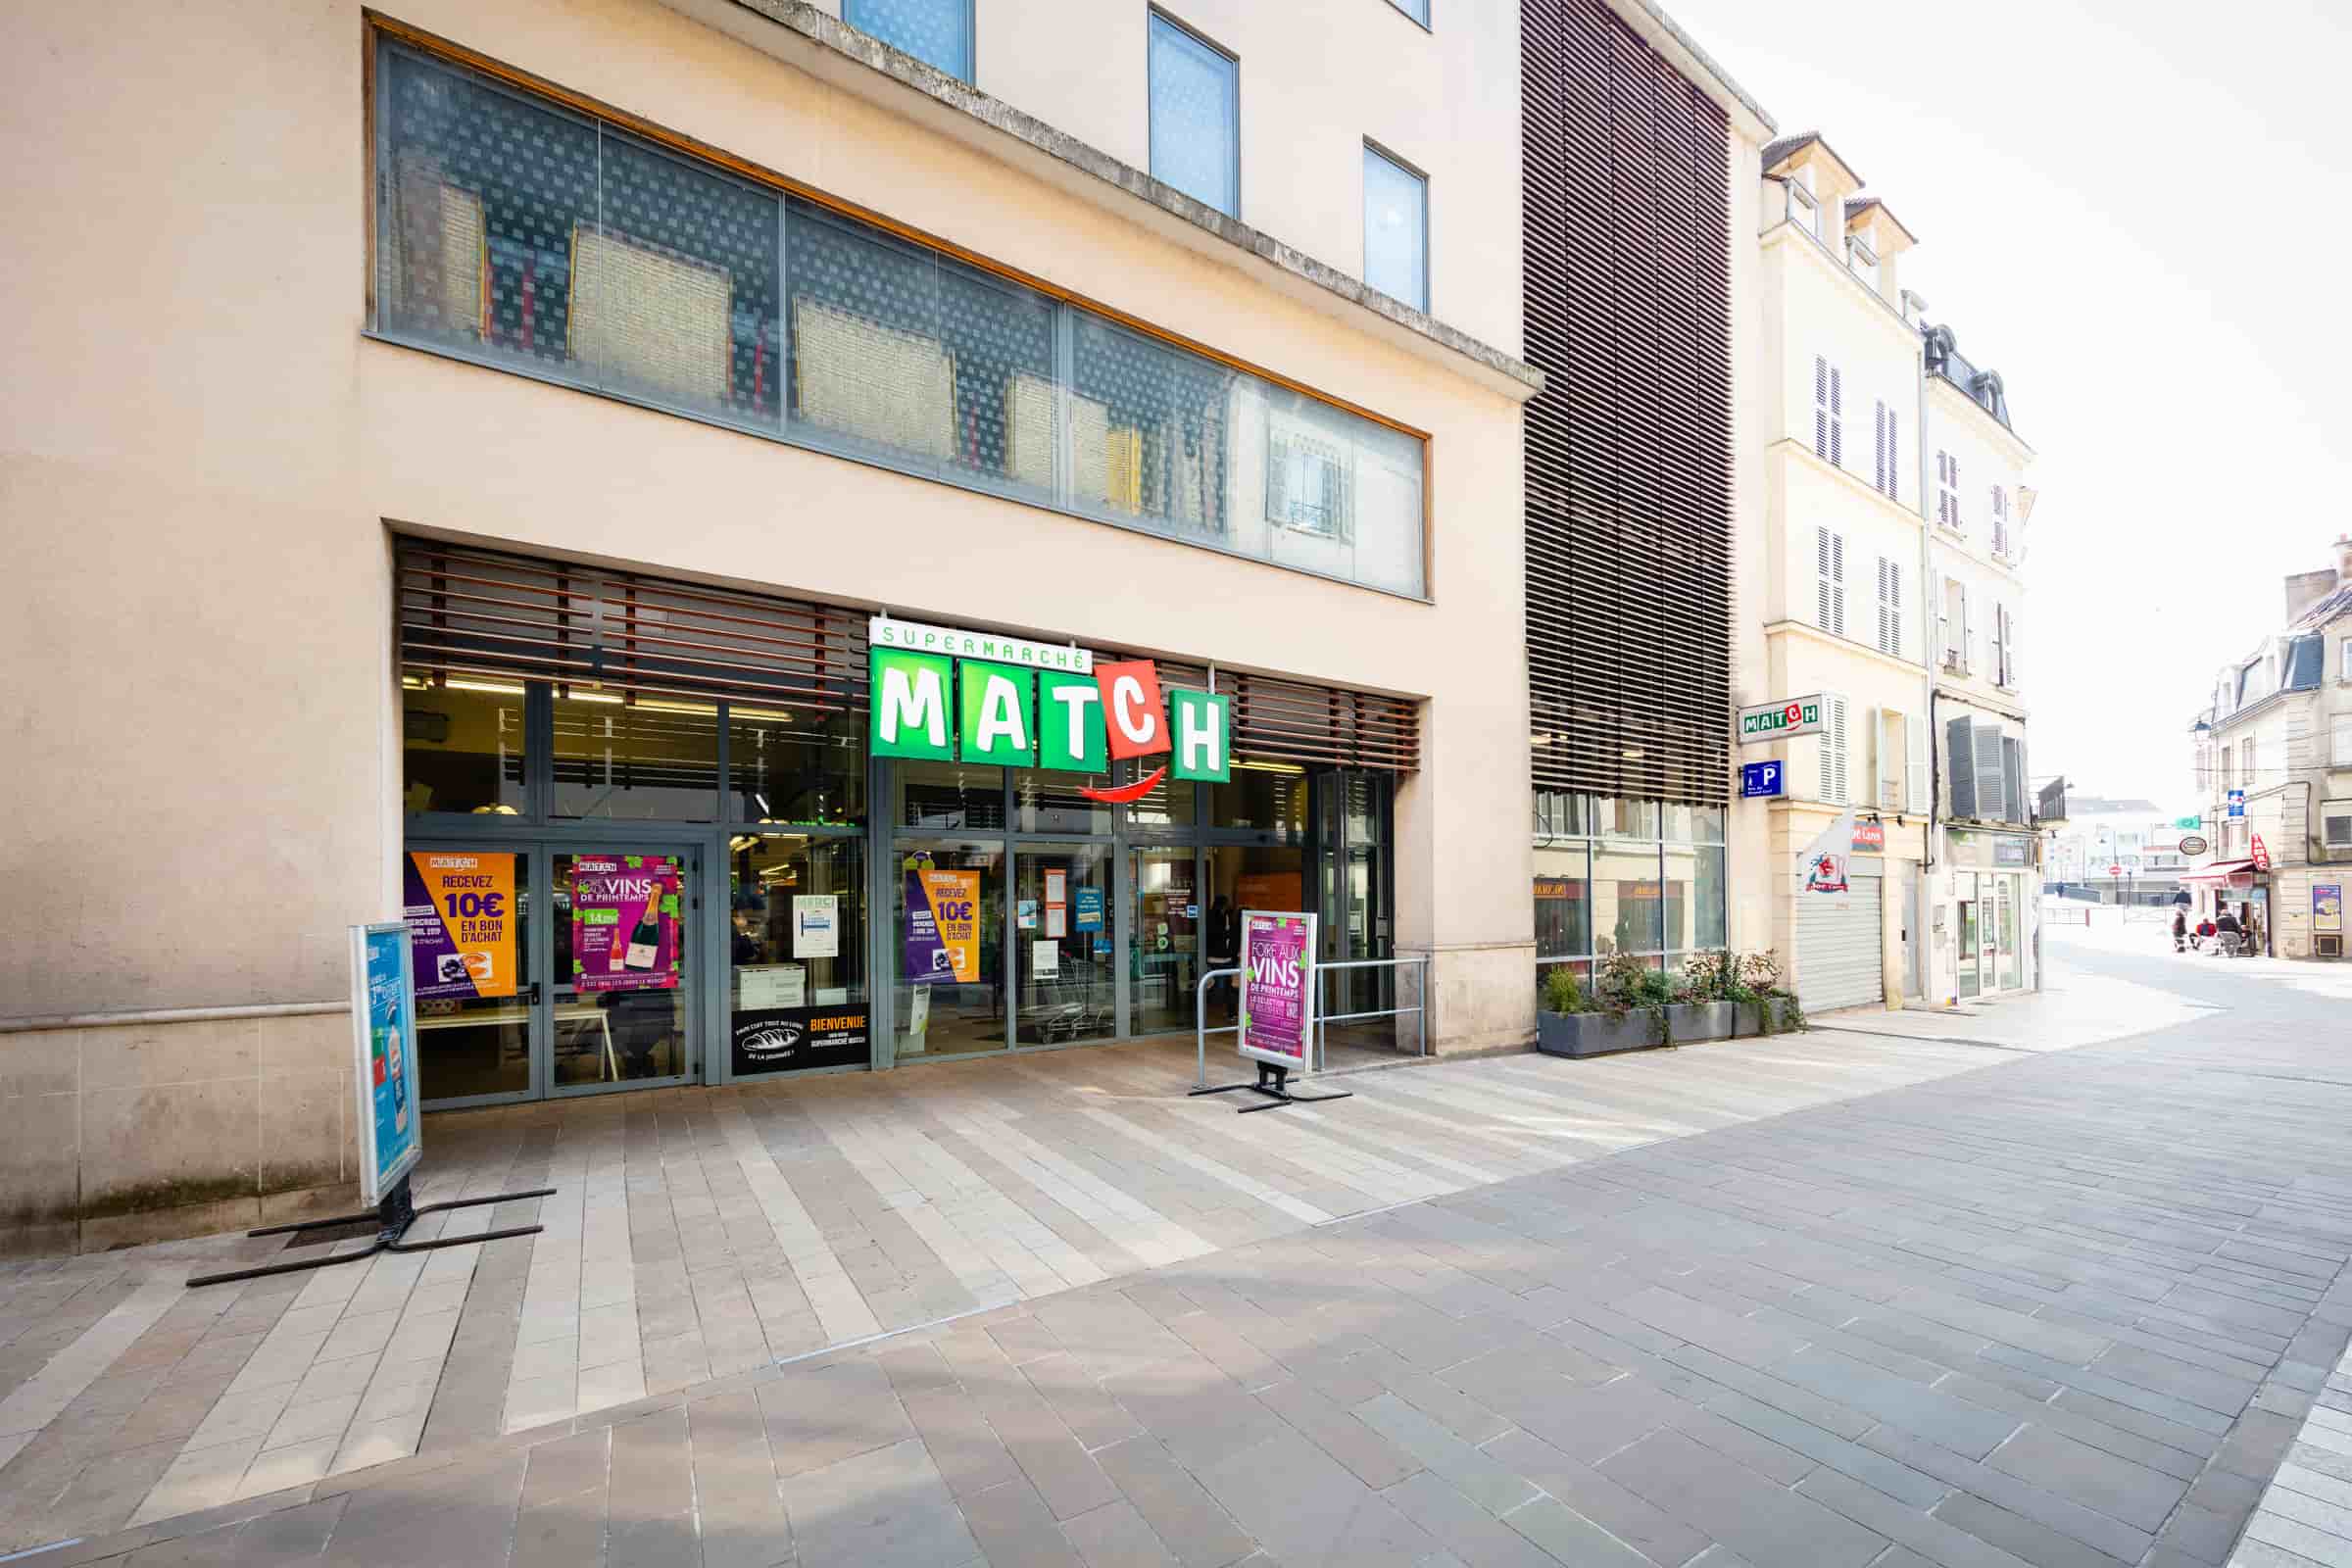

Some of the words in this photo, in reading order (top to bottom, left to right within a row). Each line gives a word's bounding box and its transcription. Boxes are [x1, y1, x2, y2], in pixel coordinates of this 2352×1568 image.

[881, 625, 1085, 670] SUPERMARCHÉ
[878, 667, 1221, 771] MATCH
[1744, 705, 1818, 732] MATCH
[1763, 767, 1776, 785] P
[442, 874, 494, 889] RECEVEZ
[605, 878, 653, 895] VINS
[444, 892, 506, 918] 10€
[937, 902, 973, 921] 10€
[461, 919, 476, 933] EN
[479, 919, 503, 932] BON
[461, 931, 503, 944] D'ACHAT
[1251, 956, 1300, 989] VINS
[809, 1015, 866, 1032] BIENVENUE
